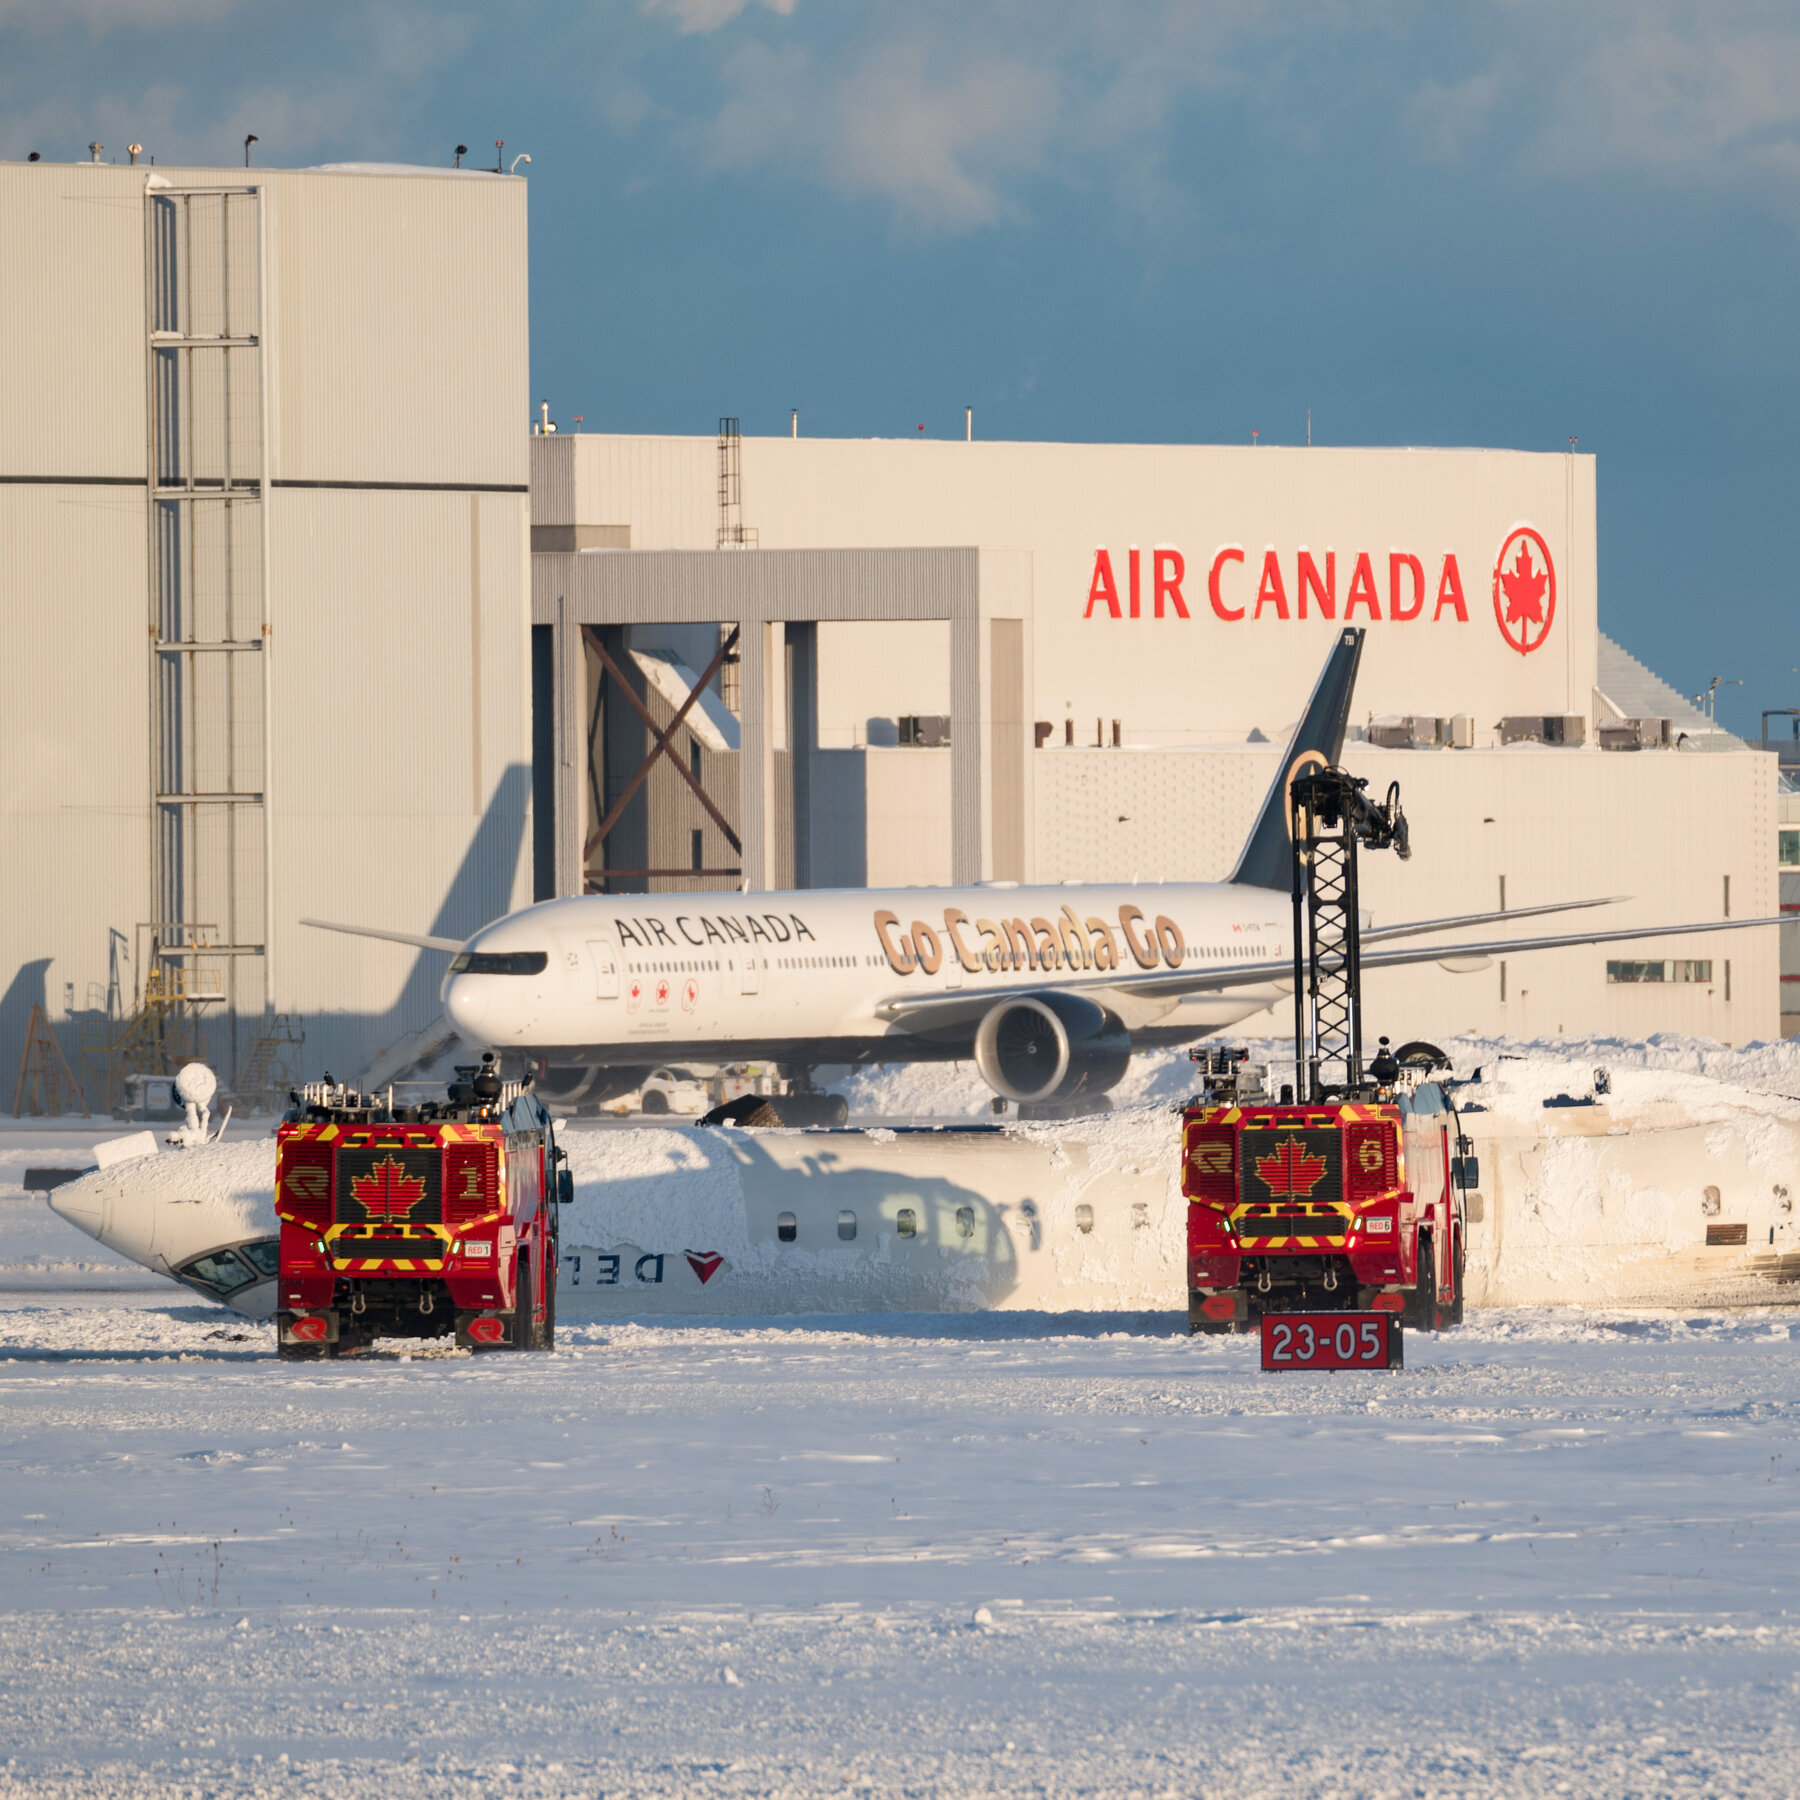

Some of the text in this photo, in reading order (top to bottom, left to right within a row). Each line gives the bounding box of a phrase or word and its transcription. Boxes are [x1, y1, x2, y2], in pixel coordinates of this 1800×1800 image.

[1083, 546, 1469, 621] AIR CANADA
[614, 913, 816, 947] AIR CANADA
[874, 904, 1186, 976] Go Canada Go
[1359, 1140, 1384, 1170] 6
[459, 1166, 484, 1199] 1
[1369, 1221, 1390, 1231] RED 6
[467, 1246, 489, 1255] RED 1
[1272, 1322, 1380, 1361] 23-05
